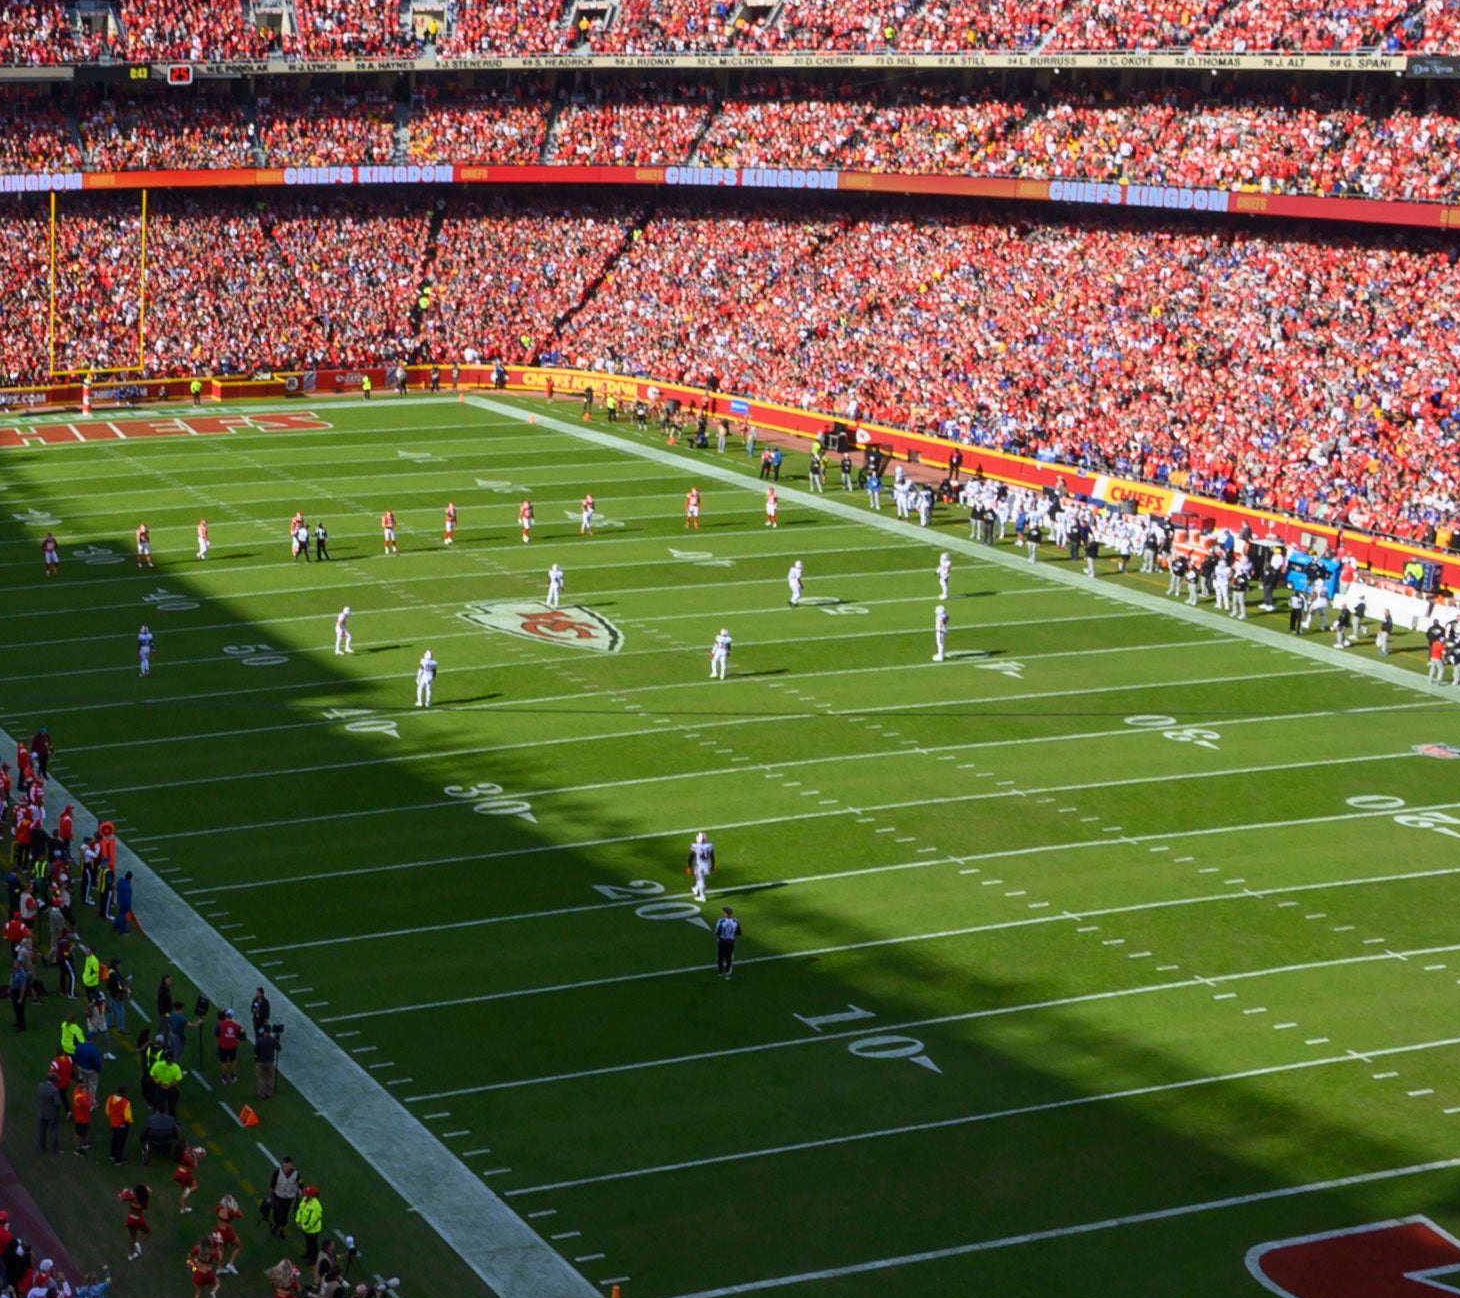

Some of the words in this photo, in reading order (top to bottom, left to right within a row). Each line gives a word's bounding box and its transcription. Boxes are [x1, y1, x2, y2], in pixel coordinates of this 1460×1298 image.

[449, 60, 503, 68] STENERUD
[545, 59, 594, 67] HEADRICK
[637, 58, 676, 66] RUDNAY
[816, 57, 855, 66] CHERRY
[897, 57, 918, 65] HILL
[961, 57, 987, 65] STILL
[1030, 57, 1077, 66] BURRUSS
[1121, 57, 1154, 66] OKOYE
[1198, 58, 1241, 67] THOMAS
[1287, 58, 1306, 67] ALT
[1357, 59, 1392, 68] SPANI
[306, 63, 337, 71] LYNCH
[170, 69, 189, 82] 25
[283, 166, 354, 185] CHIEFS
[358, 165, 453, 183] KINGDOM
[664, 166, 737, 187] CHIEFS
[741, 168, 838, 190] KINGDOM
[1049, 180, 1121, 205] CHIEFS
[1126, 185, 1229, 212] KINGDOM
[1110, 484, 1165, 510] CHIEFS
[443, 782, 531, 816] 30
[592, 879, 701, 921] 20
[792, 1004, 925, 1059] 10
